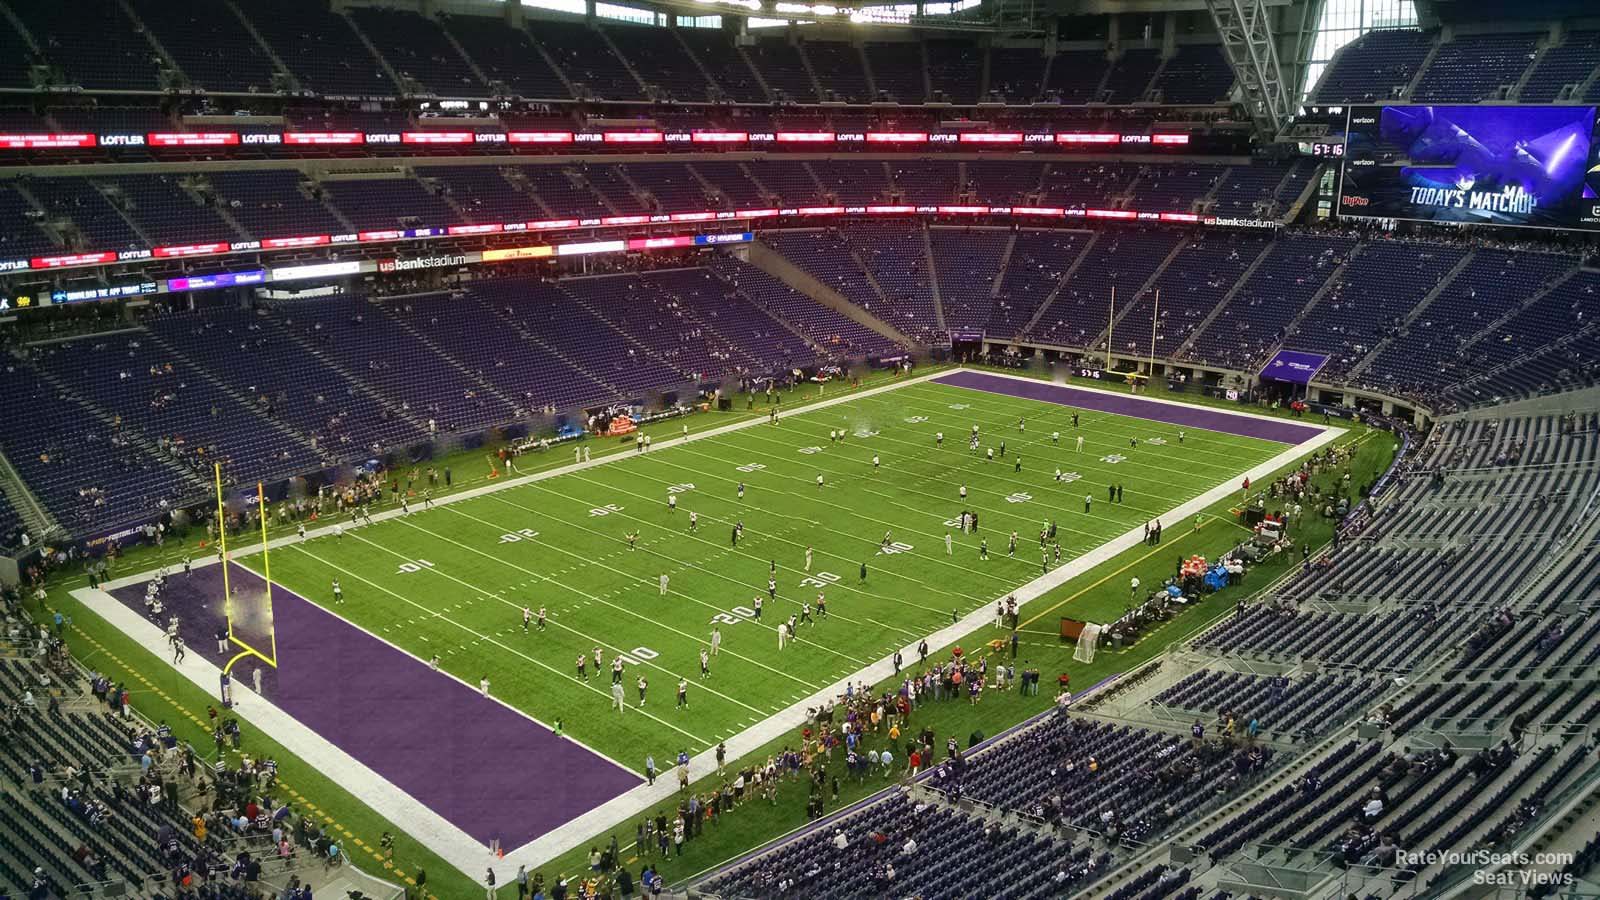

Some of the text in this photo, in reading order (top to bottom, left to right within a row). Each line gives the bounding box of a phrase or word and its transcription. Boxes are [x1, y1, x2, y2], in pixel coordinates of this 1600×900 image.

[100, 135, 145, 145] LOFFLER
[242, 134, 281, 144] LOFFLER
[366, 134, 400, 143] LOFFLER
[1313, 143, 1343, 155] 57:16
[1410, 187, 1537, 214] TODAY'S MATCHUP
[119, 249, 152, 260] LOFFLER
[0, 260, 30, 271] OFFLER
[798, 571, 842, 588] 30
[709, 606, 756, 625] 20
[621, 646, 660, 666] 10
